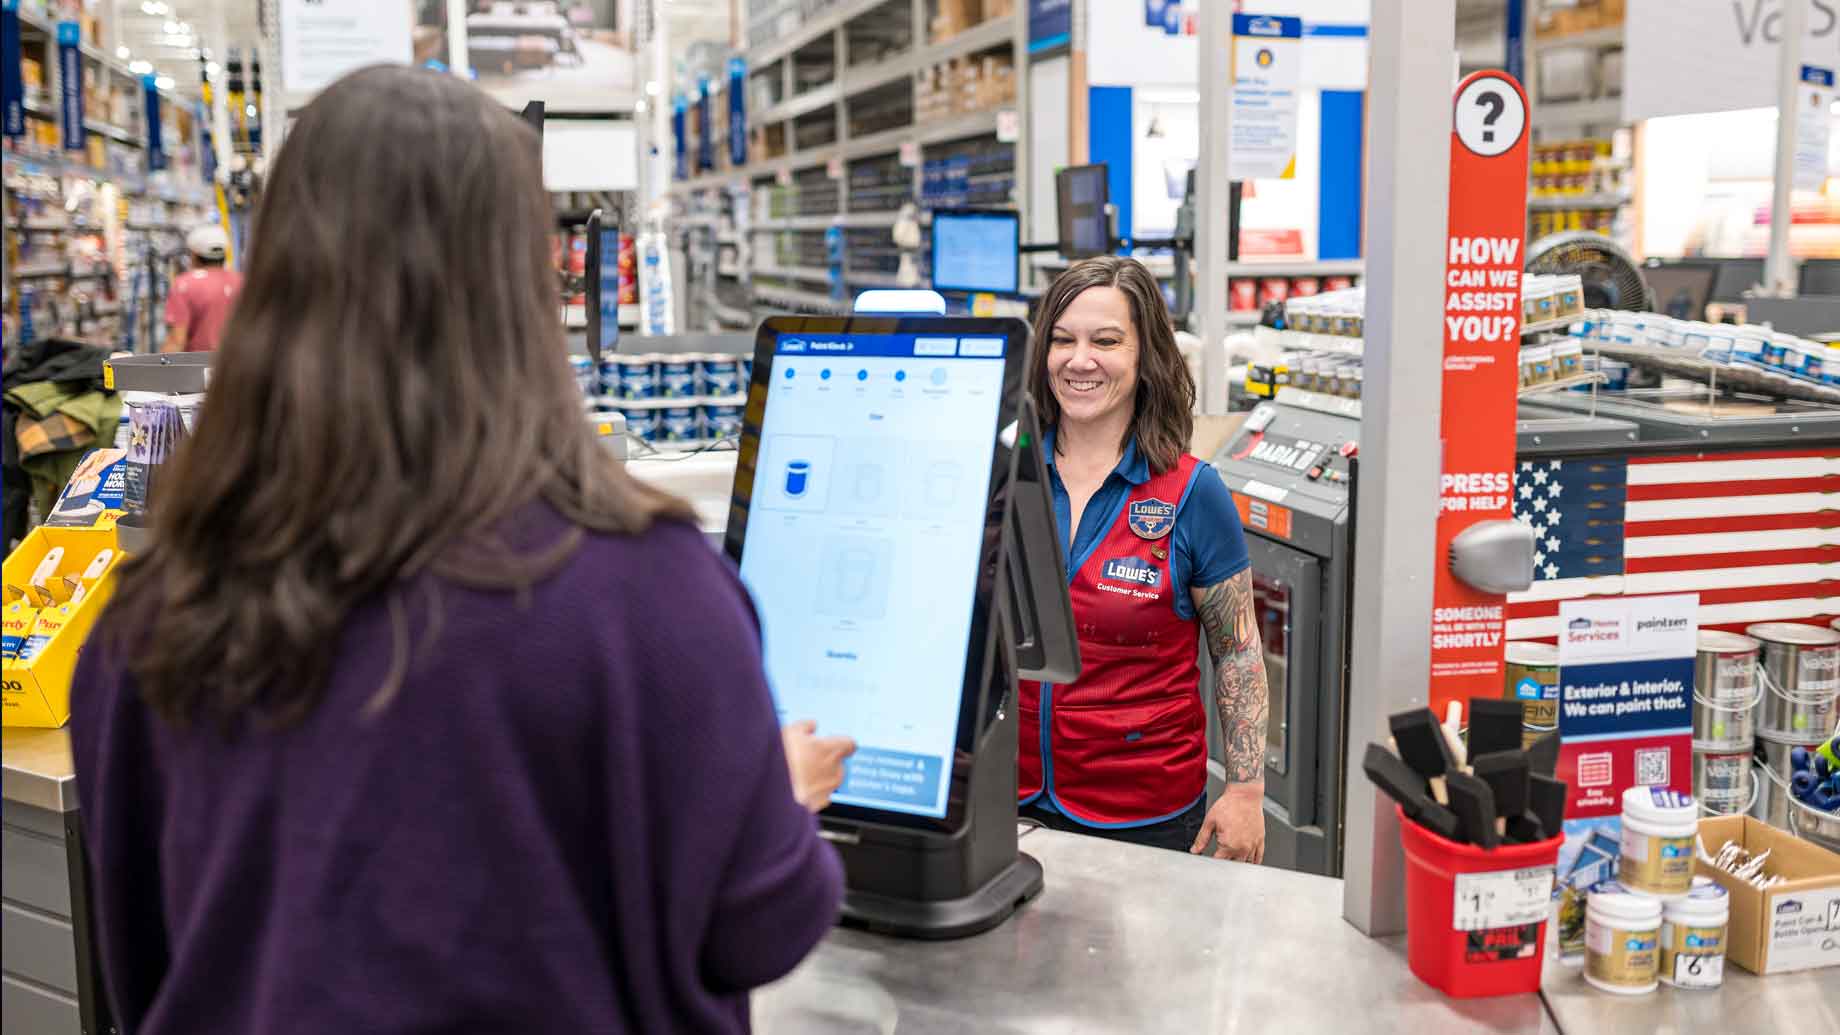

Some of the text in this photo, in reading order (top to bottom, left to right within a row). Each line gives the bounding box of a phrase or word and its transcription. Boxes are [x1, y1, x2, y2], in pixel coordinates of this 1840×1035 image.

[1448, 237, 1520, 264] HOW
[1448, 270, 1518, 287] CAN WE
[1446, 292, 1517, 310] ASSIST
[1446, 316, 1516, 342] YOU?
[1440, 472, 1510, 494] PRESS
[1134, 504, 1170, 515] LOWE'S
[1440, 495, 1508, 512] FOR HELP
[1107, 562, 1156, 584] LOWE'S
[1097, 583, 1160, 600] Customer Service
[1434, 606, 1504, 622] SOMEONE
[1432, 632, 1502, 649] SHORTLY
[1568, 630, 1620, 643] Services
[1564, 682, 1618, 700] Exterior
[1620, 682, 1630, 696] &
[1632, 678, 1684, 695] interior.
[1564, 696, 1686, 718] We can paint that.
